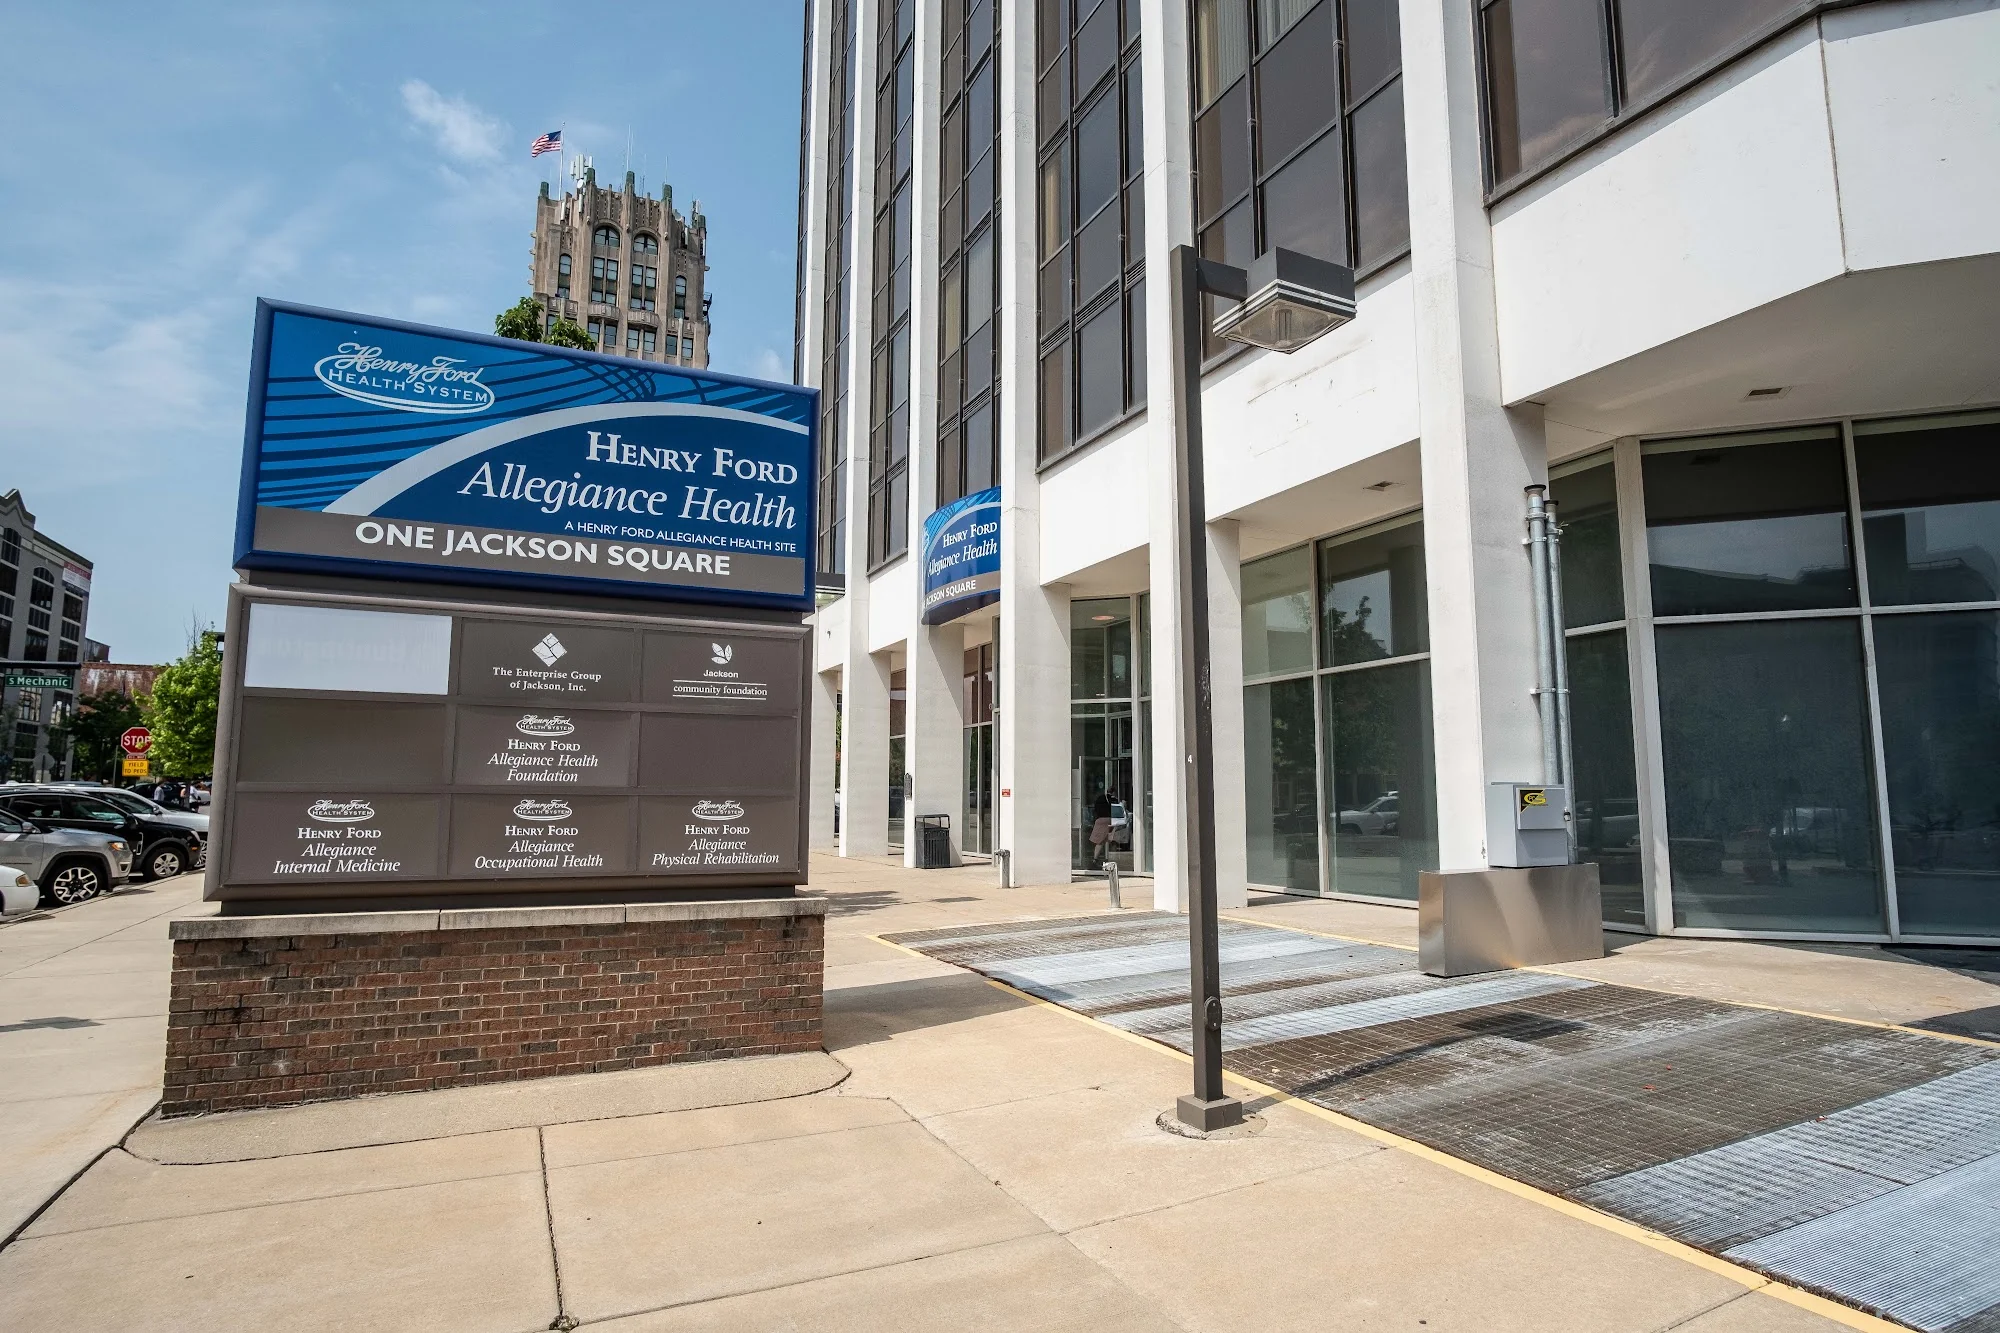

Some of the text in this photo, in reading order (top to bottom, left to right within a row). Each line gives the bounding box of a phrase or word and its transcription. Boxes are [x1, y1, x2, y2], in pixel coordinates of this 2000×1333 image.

[335, 343, 484, 383] Henry Ford
[329, 369, 487, 402] HEALTH SYSTEM
[586, 430, 798, 485] HENRY FORD
[457, 461, 796, 530] Allegiance Health
[565, 521, 796, 552] A HENRY FORD ALLEGIANCE HEALTH SITE
[943, 530, 968, 549] HENRY
[970, 522, 998, 539] FORD
[355, 521, 731, 576] ONE JACKSON SQUARE
[962, 538, 998, 562] Health
[946, 580, 976, 597] SQUARE
[493, 667, 602, 682] The Enterprise Group
[703, 669, 739, 678] Jackson
[17, 677, 68, 687] Mechanic
[510, 680, 587, 692] of Jackson, Inc.
[673, 685, 767, 696] community foundation
[123, 735, 153, 746] STOP
[508, 739, 580, 751] HENRY FORD
[487, 753, 598, 768] Allegiance Health
[1187, 754, 1193, 763] 4
[507, 768, 578, 782] Foundation
[298, 827, 381, 839] HENRY FORD
[504, 825, 578, 836] HENRY FORD
[684, 824, 750, 835] HENRY FORD
[301, 843, 376, 859] Allegiance
[508, 840, 575, 855] Allegiance
[688, 839, 747, 853] Allegiance
[273, 858, 400, 874] Internal Medicine
[475, 854, 603, 872] Occupational Health
[652, 852, 779, 868] Physical Rehabilitation
